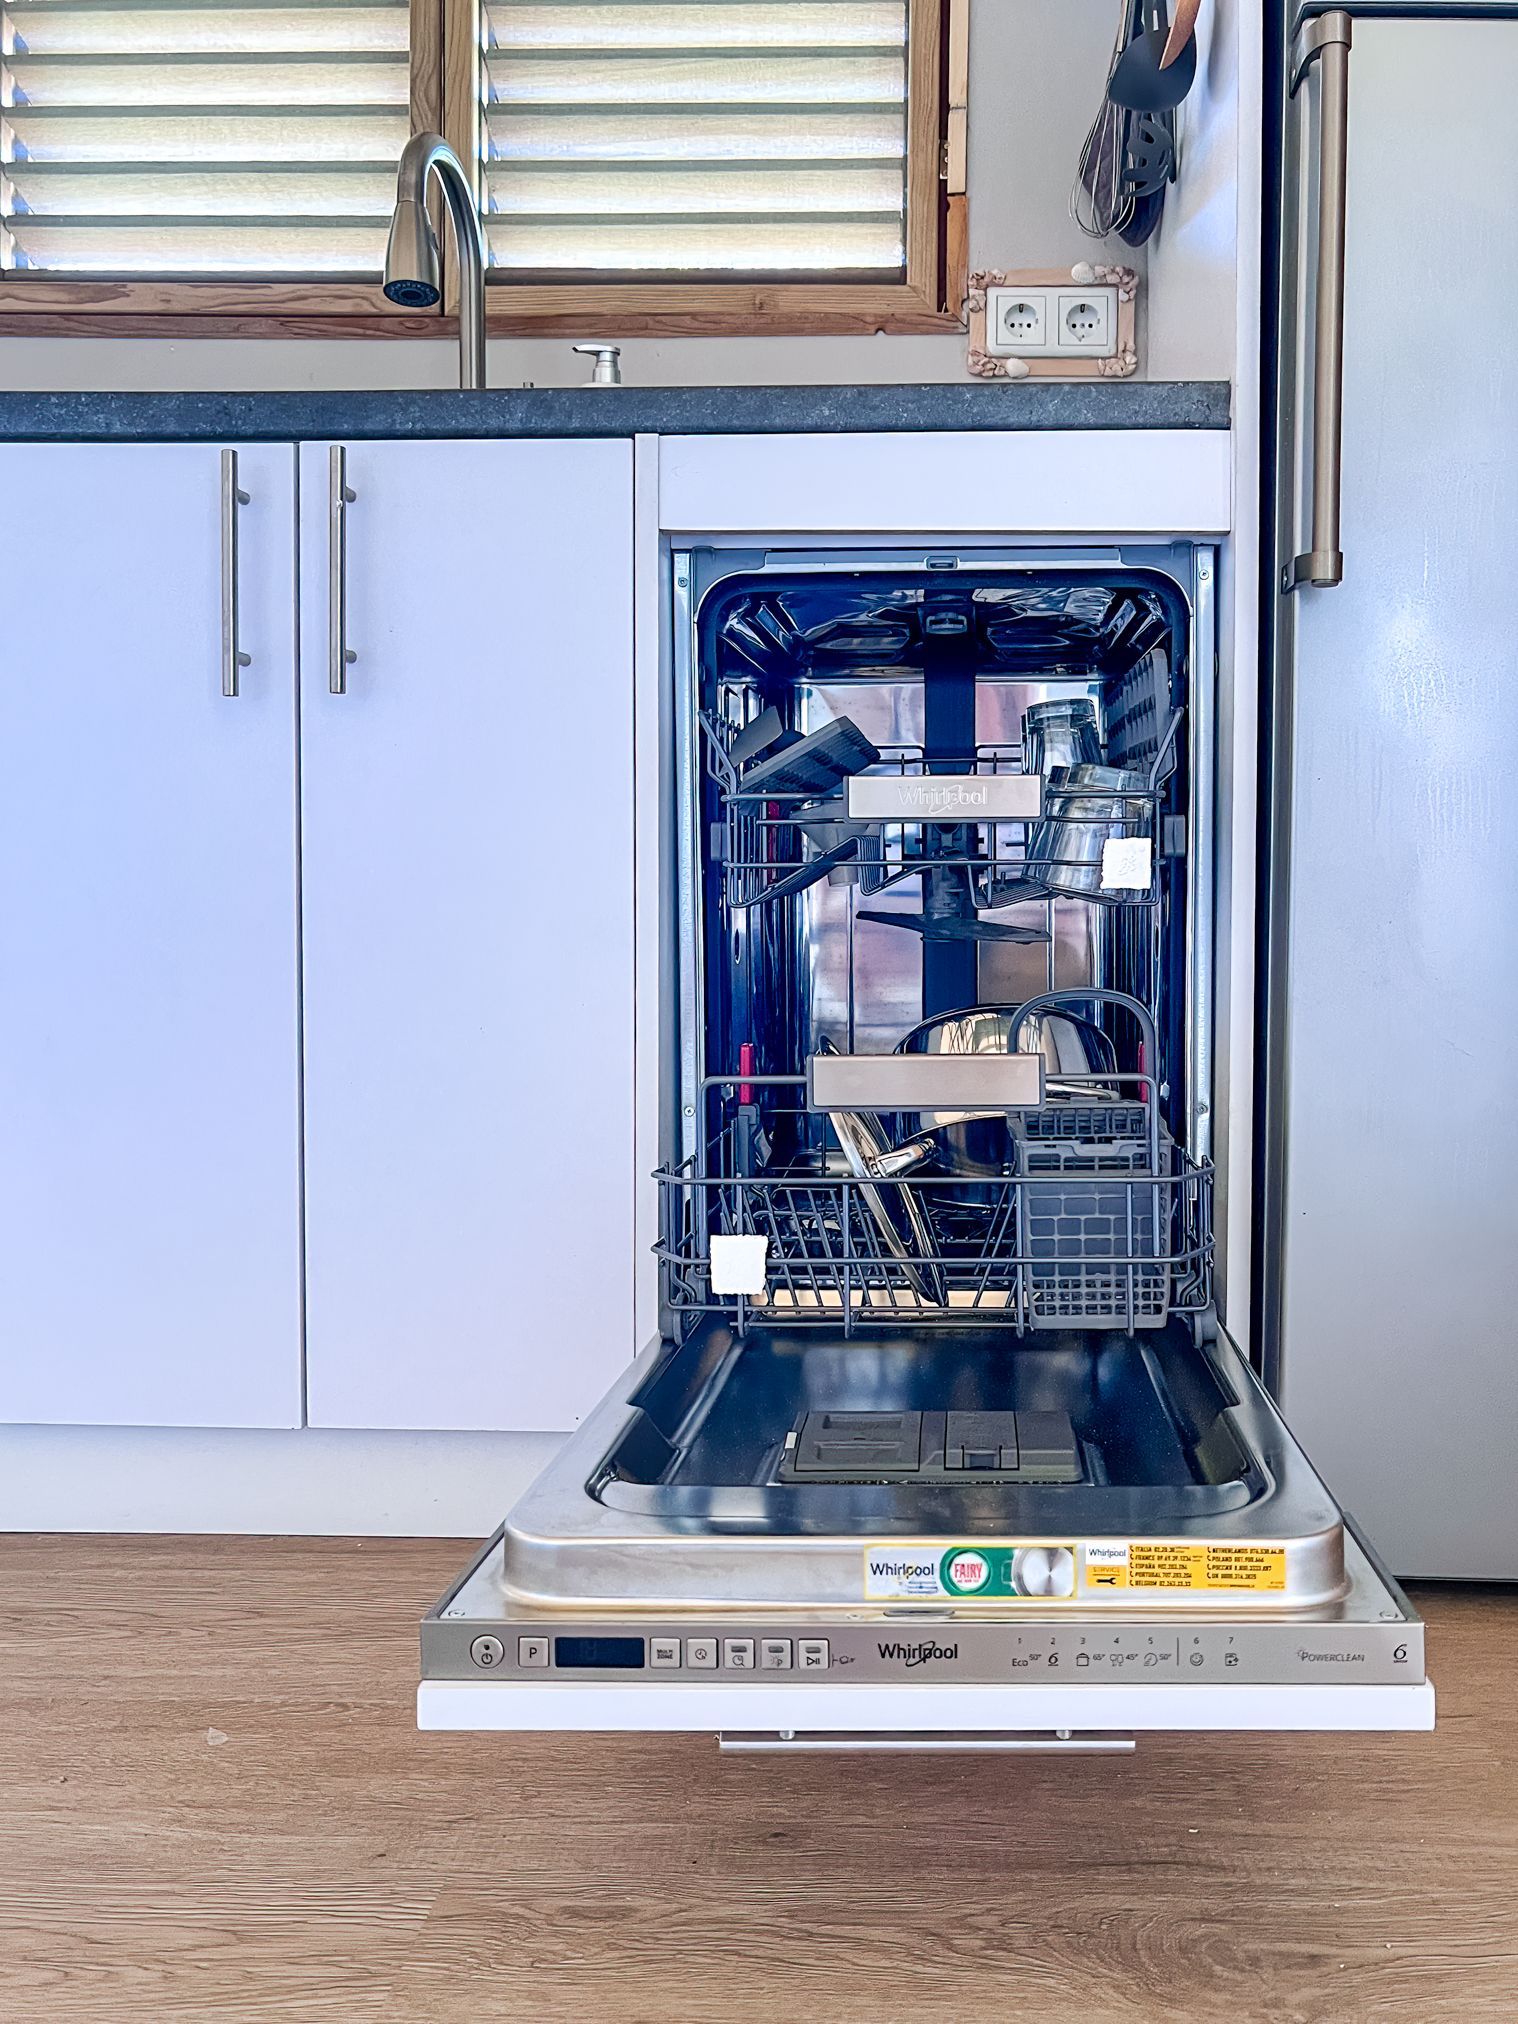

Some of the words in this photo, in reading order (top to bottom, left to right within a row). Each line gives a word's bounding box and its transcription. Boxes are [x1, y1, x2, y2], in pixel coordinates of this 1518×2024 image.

[898, 785, 988, 812] Whirlpool
[1089, 1548, 1127, 1558] Whirlpool
[870, 1562, 934, 1579] Whirlpool
[954, 1562, 983, 1578] FAIRY
[529, 1647, 538, 1659] P
[877, 1642, 959, 1665] Whirlpool
[1393, 1643, 1408, 1661] 6
[1011, 1658, 1029, 1667] Eco
